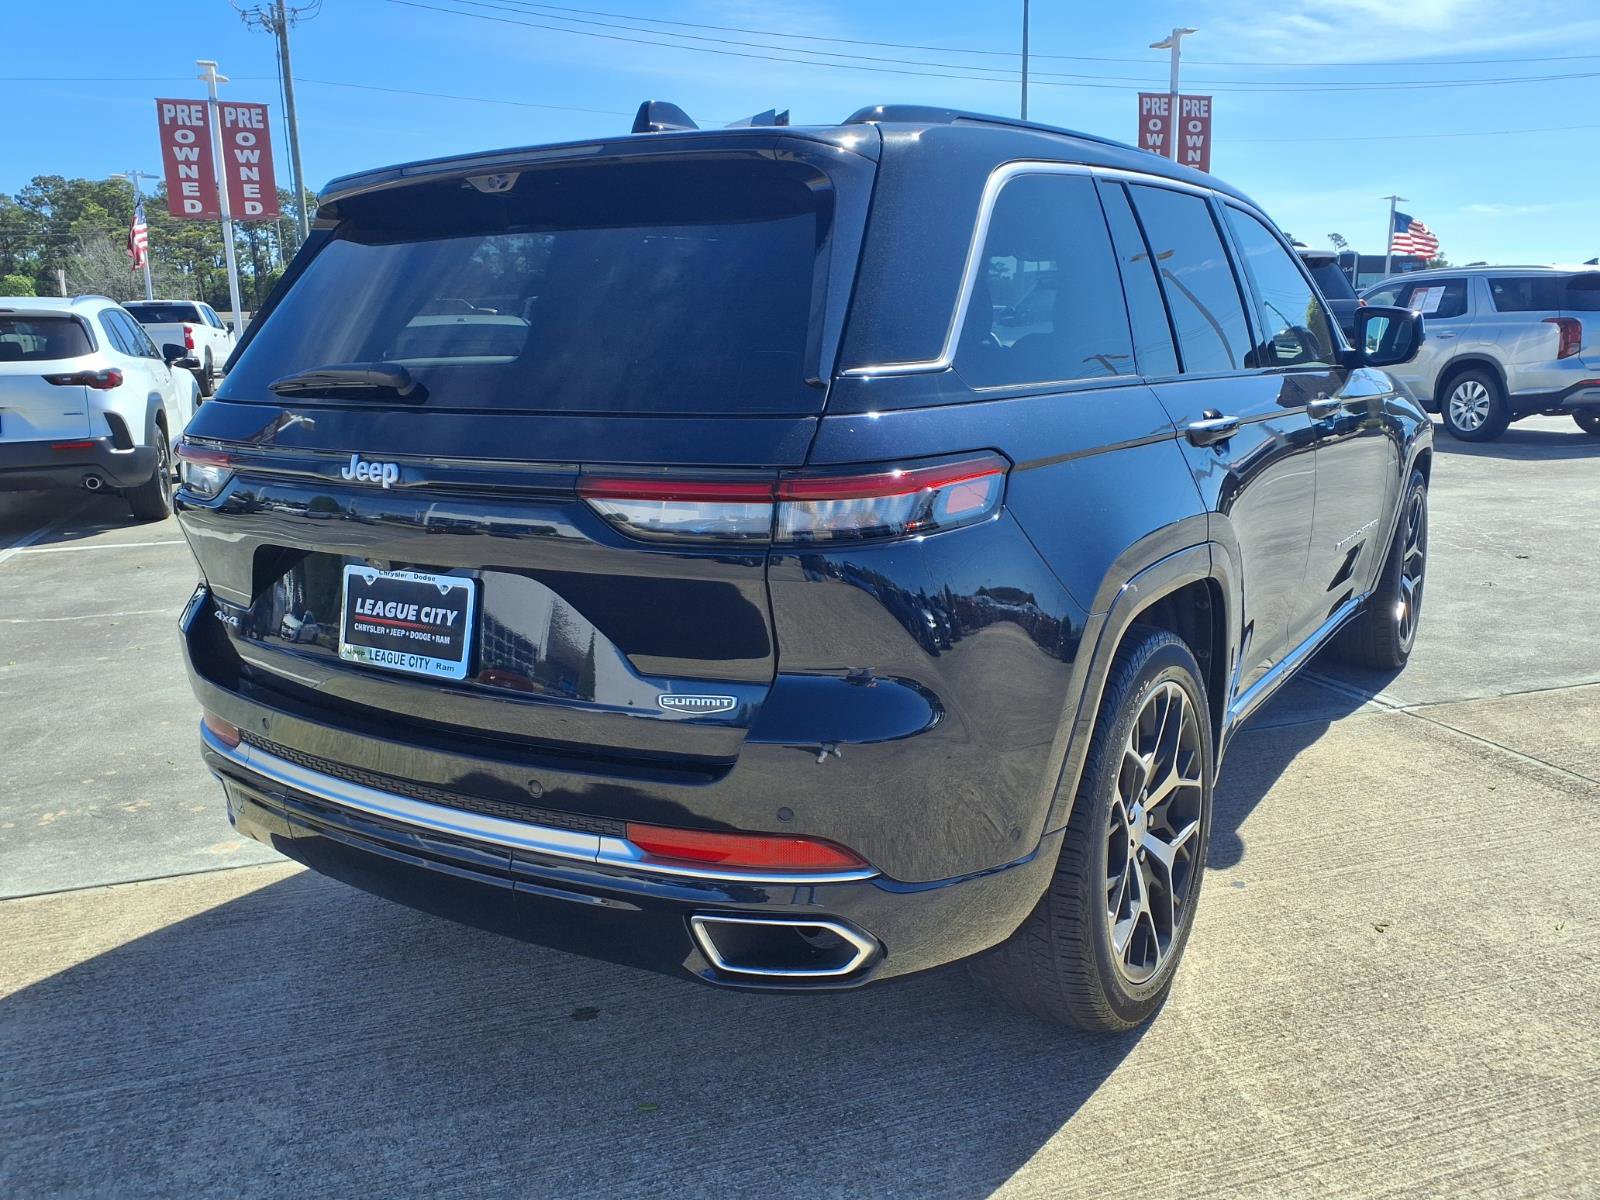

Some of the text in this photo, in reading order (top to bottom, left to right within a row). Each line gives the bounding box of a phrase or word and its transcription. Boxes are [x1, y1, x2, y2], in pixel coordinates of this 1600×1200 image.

[162, 103, 204, 126] PRE
[223, 106, 264, 129] PRE
[1142, 97, 1169, 116] PRE
[1182, 99, 1209, 118] PRE
[1185, 120, 1204, 168] OWN
[172, 129, 203, 213] OWNED
[233, 131, 264, 215] OWNED
[341, 454, 399, 489] Jeep
[378, 569, 436, 582] Chrysler Dodge
[214, 610, 239, 626] 4x4
[355, 597, 458, 626] LEAGUE CITY
[354, 622, 451, 645] CHRYSLER JEEP DODGE RAM
[369, 649, 406, 666] LEAGUE
[408, 655, 431, 670] CITY
[436, 662, 455, 672] Ram
[662, 697, 732, 707] SUMMIT
